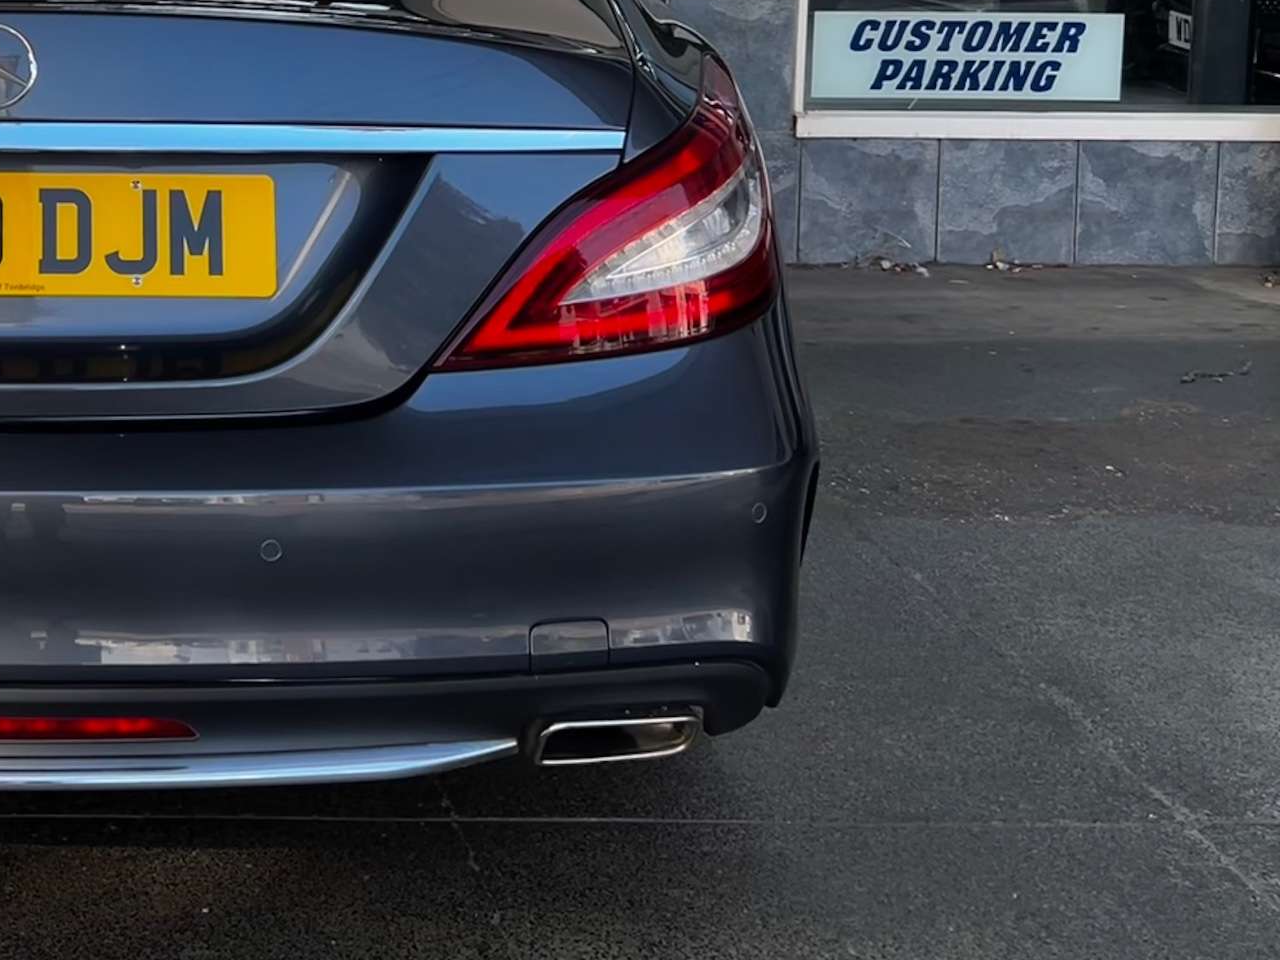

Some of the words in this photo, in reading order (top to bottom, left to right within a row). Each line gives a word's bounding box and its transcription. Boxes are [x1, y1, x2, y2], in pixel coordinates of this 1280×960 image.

[849, 19, 1087, 54] CUSTOMER
[870, 58, 1063, 93] PARKING
[38, 187, 224, 276] DJM
